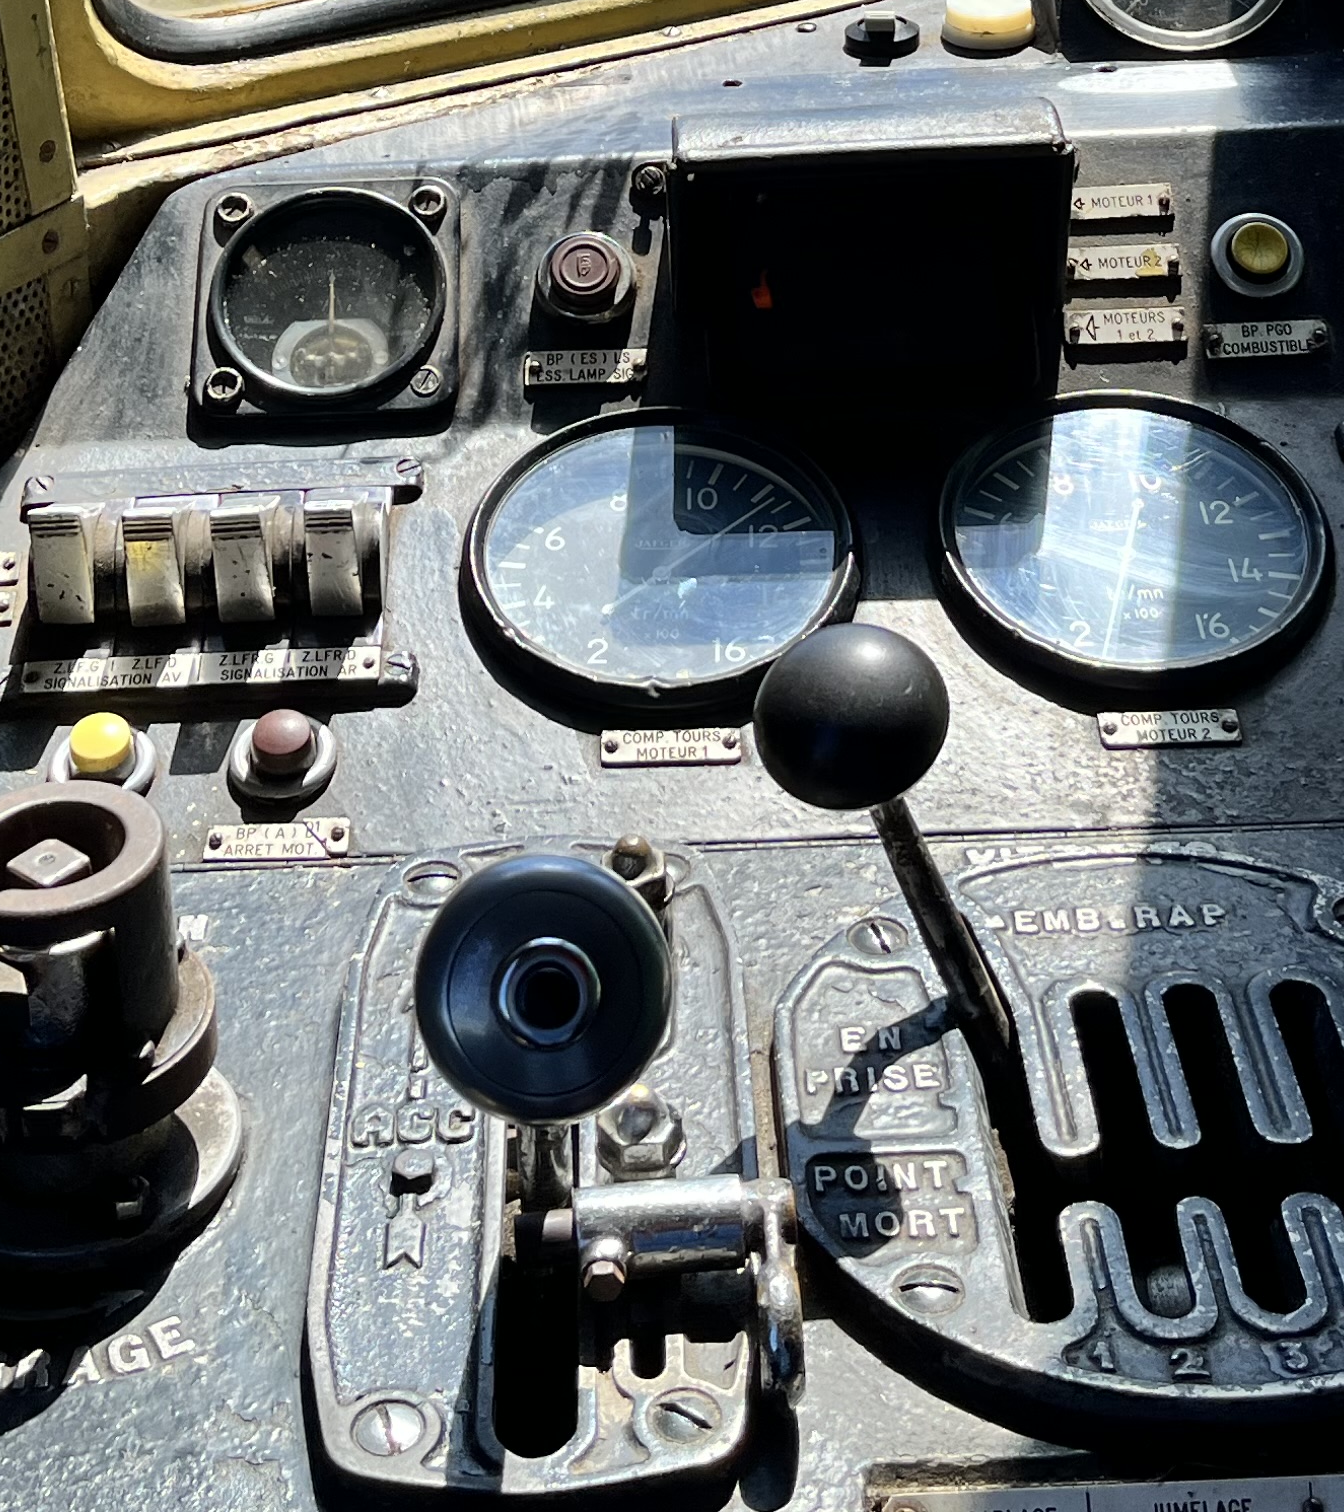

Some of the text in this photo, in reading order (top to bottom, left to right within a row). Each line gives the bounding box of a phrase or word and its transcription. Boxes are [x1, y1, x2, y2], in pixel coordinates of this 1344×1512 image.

[1091, 195, 1153, 209] MOTEUR 1
[1098, 255, 1162, 269] MOTEUR 2
[1104, 311, 1165, 326] MOTEURS
[1266, 323, 1292, 336] PGO
[547, 352, 630, 365] BP LS
[686, 486, 719, 512] 10
[1199, 500, 1234, 525] 12
[545, 526, 566, 551] 6
[1228, 557, 1264, 583] 14
[534, 586, 555, 609] 4
[1195, 613, 1231, 639] 16
[587, 638, 608, 665] 2
[713, 638, 747, 663] 16
[44, 671, 182, 690] SIGNALISATION AV
[220, 662, 357, 681] SIGNALISATION AR
[1170, 711, 1219, 724] TOURS
[673, 730, 721, 742] TOURS
[1136, 728, 1212, 741] MOTEUR 2
[636, 746, 708, 759] MOTEUR 1
[236, 826, 258, 841] BP
[224, 841, 274, 857] ARRET
[841, 1026, 902, 1052] EN
[805, 1065, 941, 1093] PRISE
[814, 1161, 949, 1192] POINT
[839, 1209, 966, 1239] MORT
[1091, 1343, 1117, 1372] 1
[1169, 1346, 1212, 1379] 2
[1279, 1341, 1314, 1372] 3
